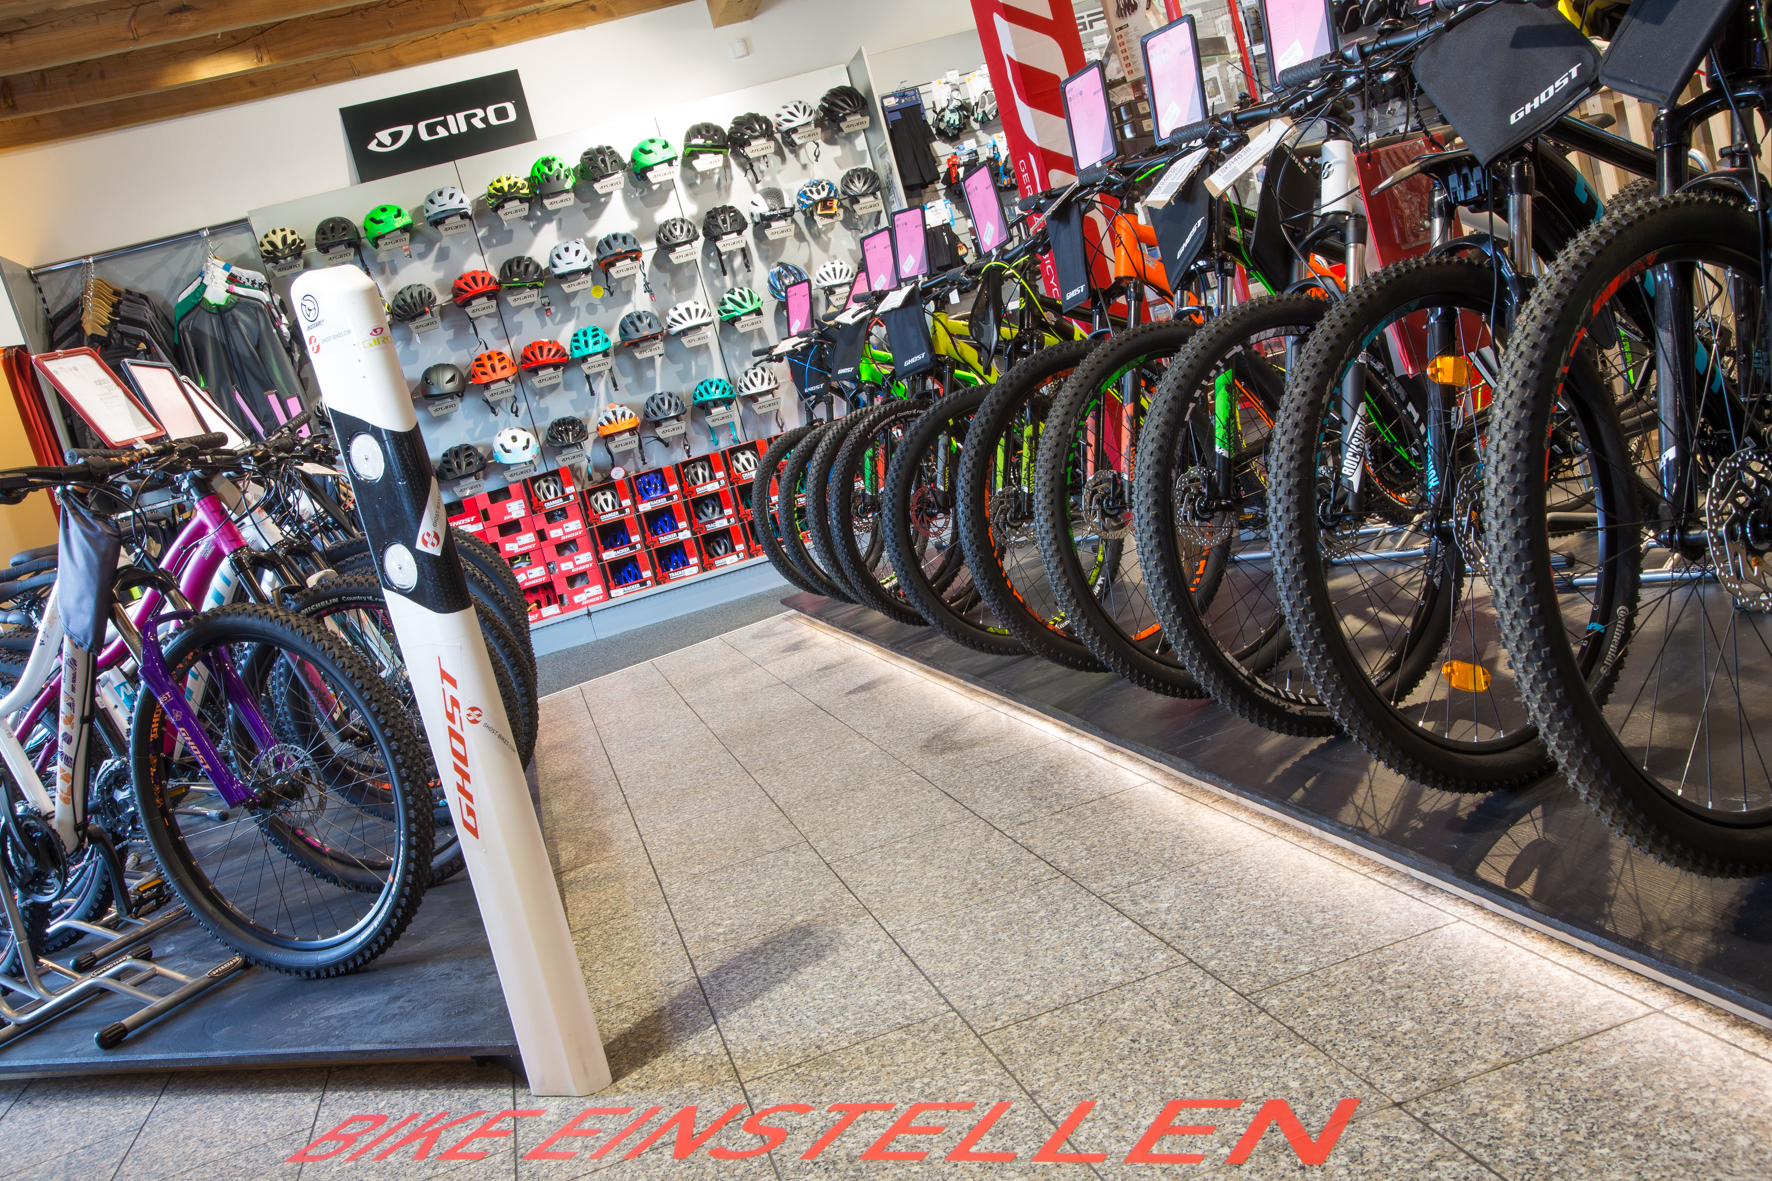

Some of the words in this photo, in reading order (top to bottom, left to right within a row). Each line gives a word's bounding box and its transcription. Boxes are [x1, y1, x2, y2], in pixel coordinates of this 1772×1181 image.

[1510, 62, 1582, 125] GHOST
[417, 101, 517, 142] GIRO
[1176, 216, 1204, 260] GHOST
[1066, 284, 1086, 300] GHOST
[362, 336, 392, 348] GIRO
[904, 352, 926, 367] GHOST
[838, 366, 854, 374] GHOST
[804, 382, 824, 392] GHOST
[561, 530, 584, 540] GHOST
[572, 562, 594, 572] GHOST
[524, 576, 546, 586] GHOST
[300, 598, 339, 614] MICHELIN
[582, 594, 604, 605] GHOST
[483, 722, 516, 754] GHOST-BIKES.COM
[178, 727, 212, 772] GHOST
[438, 656, 479, 839] GHOST
[284, 1110, 549, 1163] BIKE
[522, 1098, 1361, 1166] EINSTELLEN
